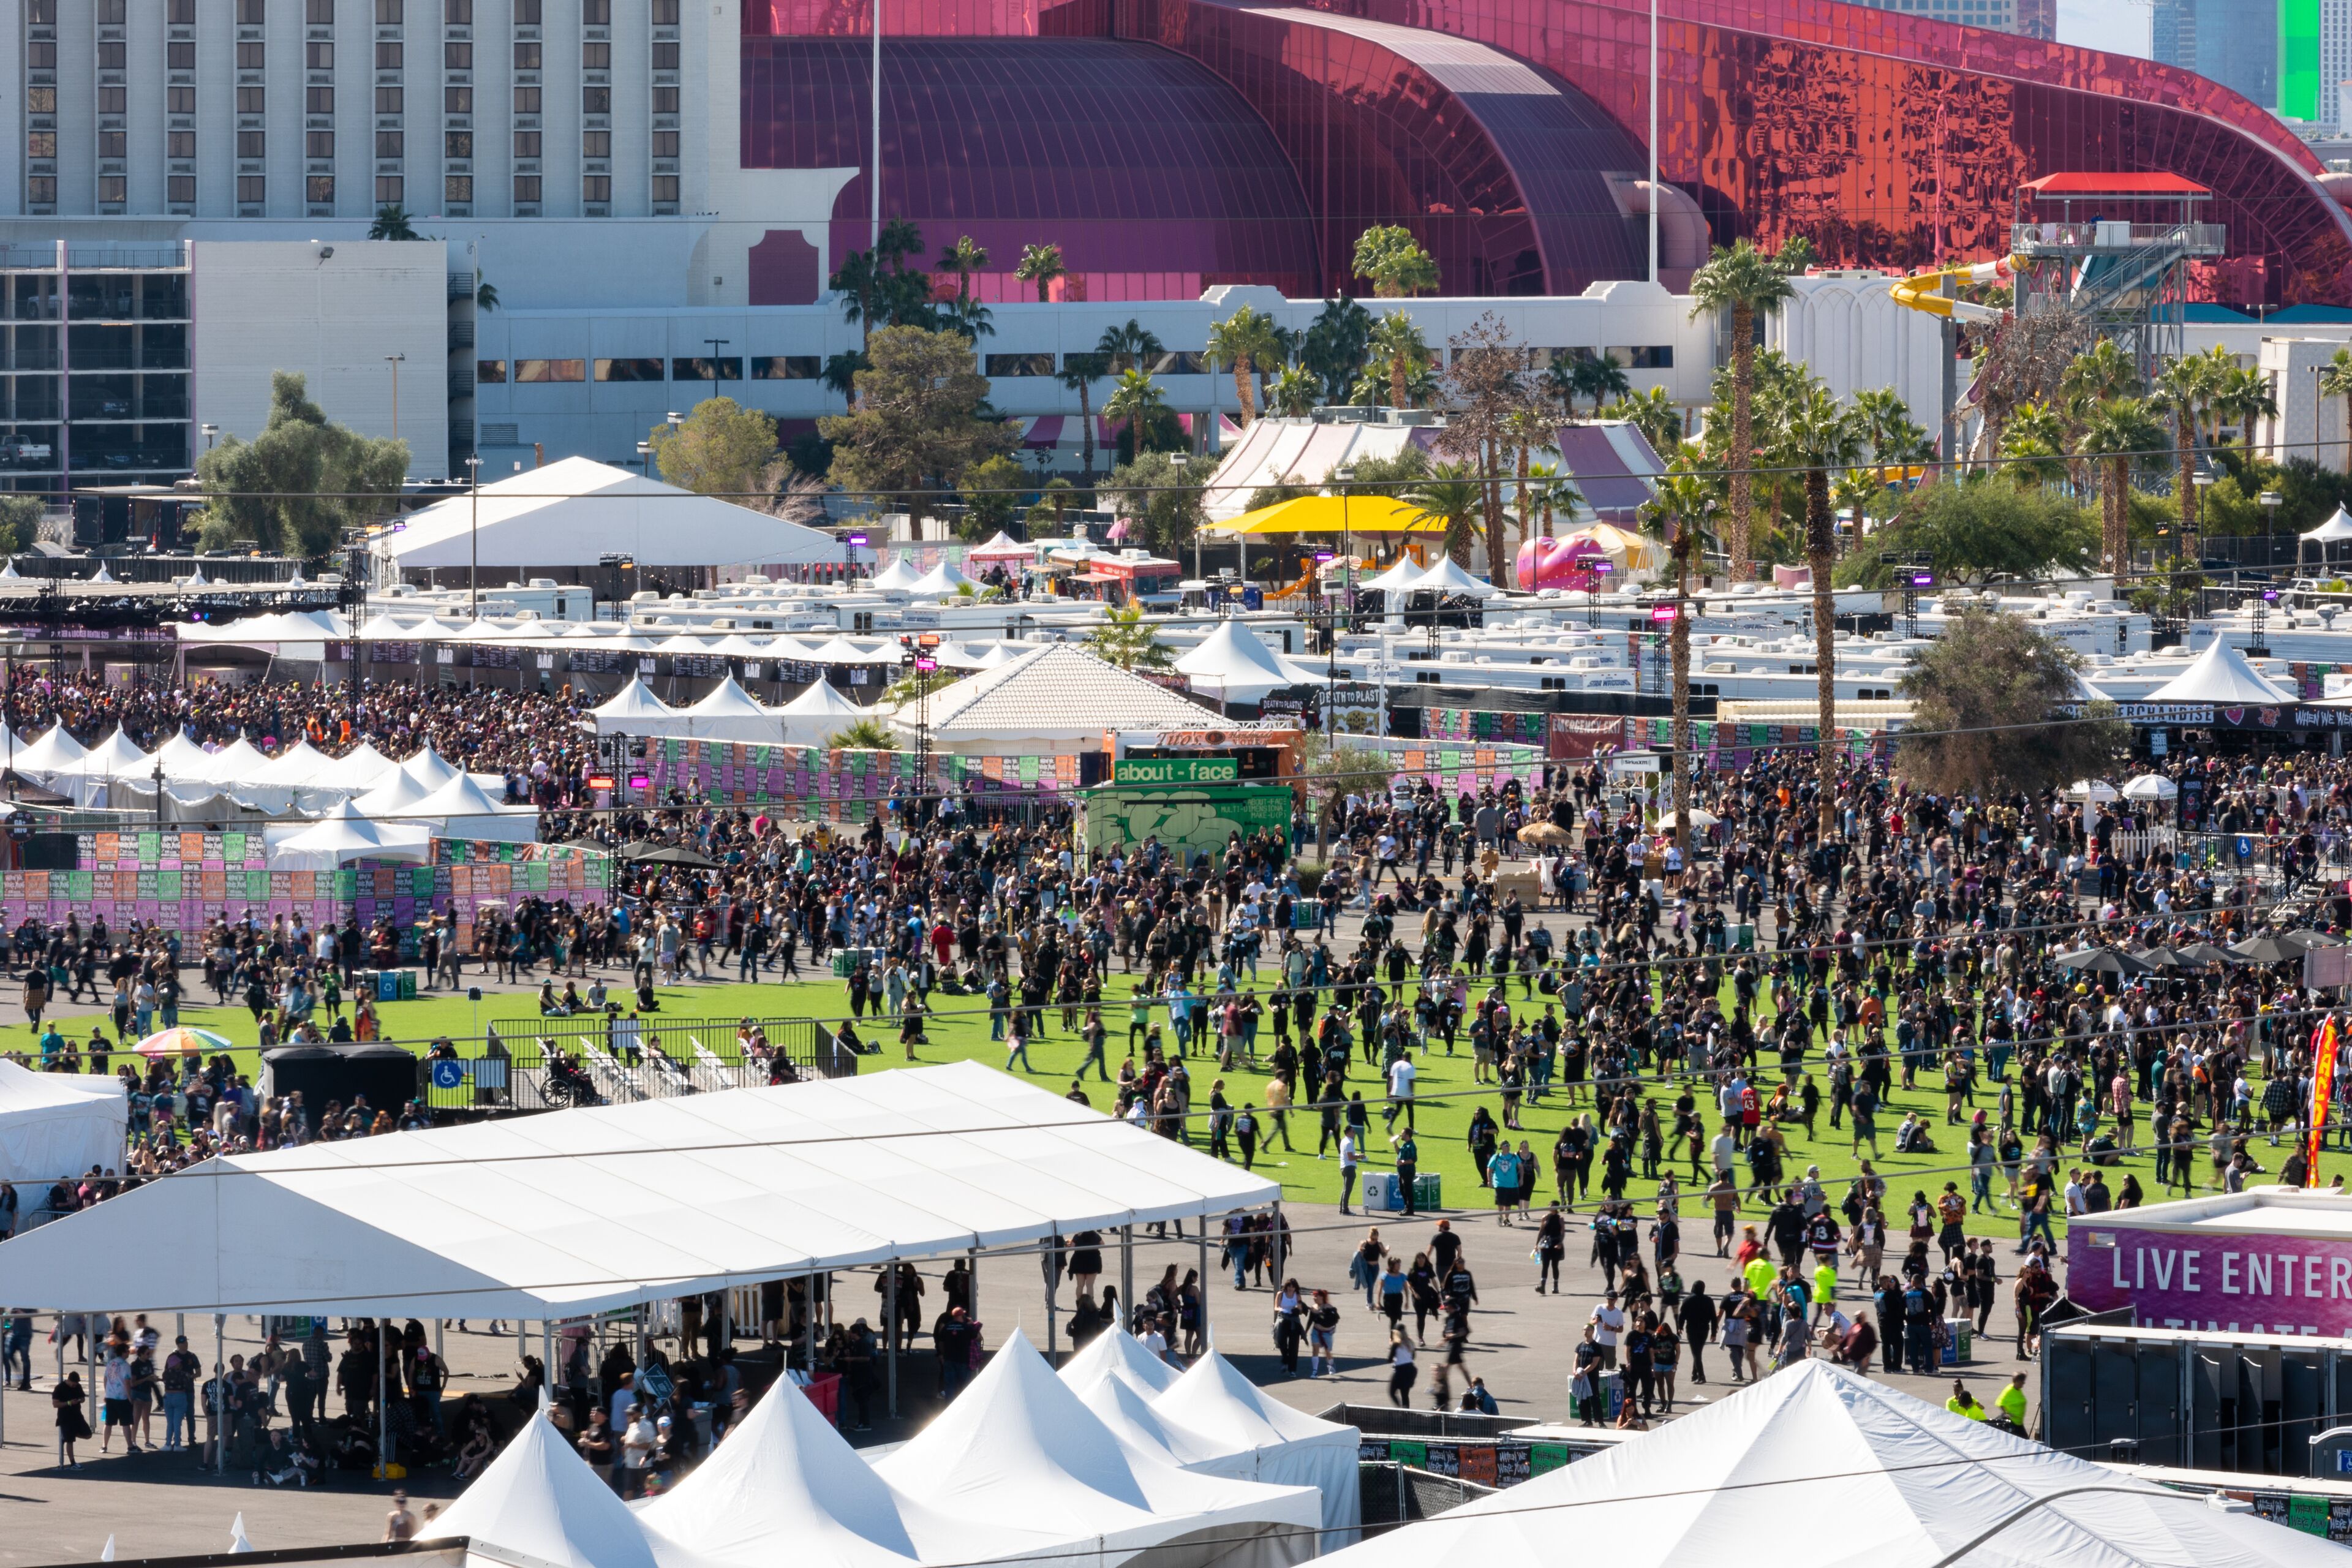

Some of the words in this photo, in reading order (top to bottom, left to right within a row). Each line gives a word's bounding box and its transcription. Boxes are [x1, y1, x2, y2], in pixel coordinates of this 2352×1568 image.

[437, 649, 453, 663] BAR
[537, 654, 553, 669] BAR
[639, 658, 655, 673] BAR
[744, 663, 761, 678] BAR
[850, 669, 867, 685] BAR
[1319, 690, 1346, 705] DEATH
[1356, 688, 1389, 704] PLASTC
[1263, 699, 1279, 709] DEATH
[1284, 700, 1303, 710] PLASTIC
[2117, 705, 2212, 722] ERCHANDISE
[2295, 710, 2320, 726] WHEN
[2321, 710, 2335, 726] WE
[1552, 718, 1601, 734] EMERGENCY
[1604, 721, 1622, 734] EXIT
[1228, 730, 1274, 739] Handmade
[1117, 763, 1173, 781] about
[1189, 762, 1235, 781] face
[1744, 1100, 1755, 1110] 43
[1815, 1226, 1828, 1240] 13
[2113, 1246, 2201, 1291] LIVE
[2222, 1251, 2352, 1300] ENTER
[1430, 1449, 1446, 1463] WHEN
[1446, 1450, 1457, 1461] WE
[1499, 1451, 1517, 1463] WHEN
[1517, 1452, 1528, 1461] WE
[1426, 1462, 1443, 1473] WERE
[1444, 1461, 1460, 1476] YOUNG
[1498, 1463, 1513, 1475] WERE
[1513, 1462, 1530, 1476] YOUNG
[2257, 1499, 2274, 1512] WHEN
[2275, 1501, 2285, 1512] WE
[2296, 1502, 2313, 1515] WHEN
[2314, 1504, 2324, 1515] WE
[2332, 1505, 2351, 1518] WHEN
[2291, 1515, 2309, 1529] WERE
[2330, 1519, 2346, 1532] WERE
